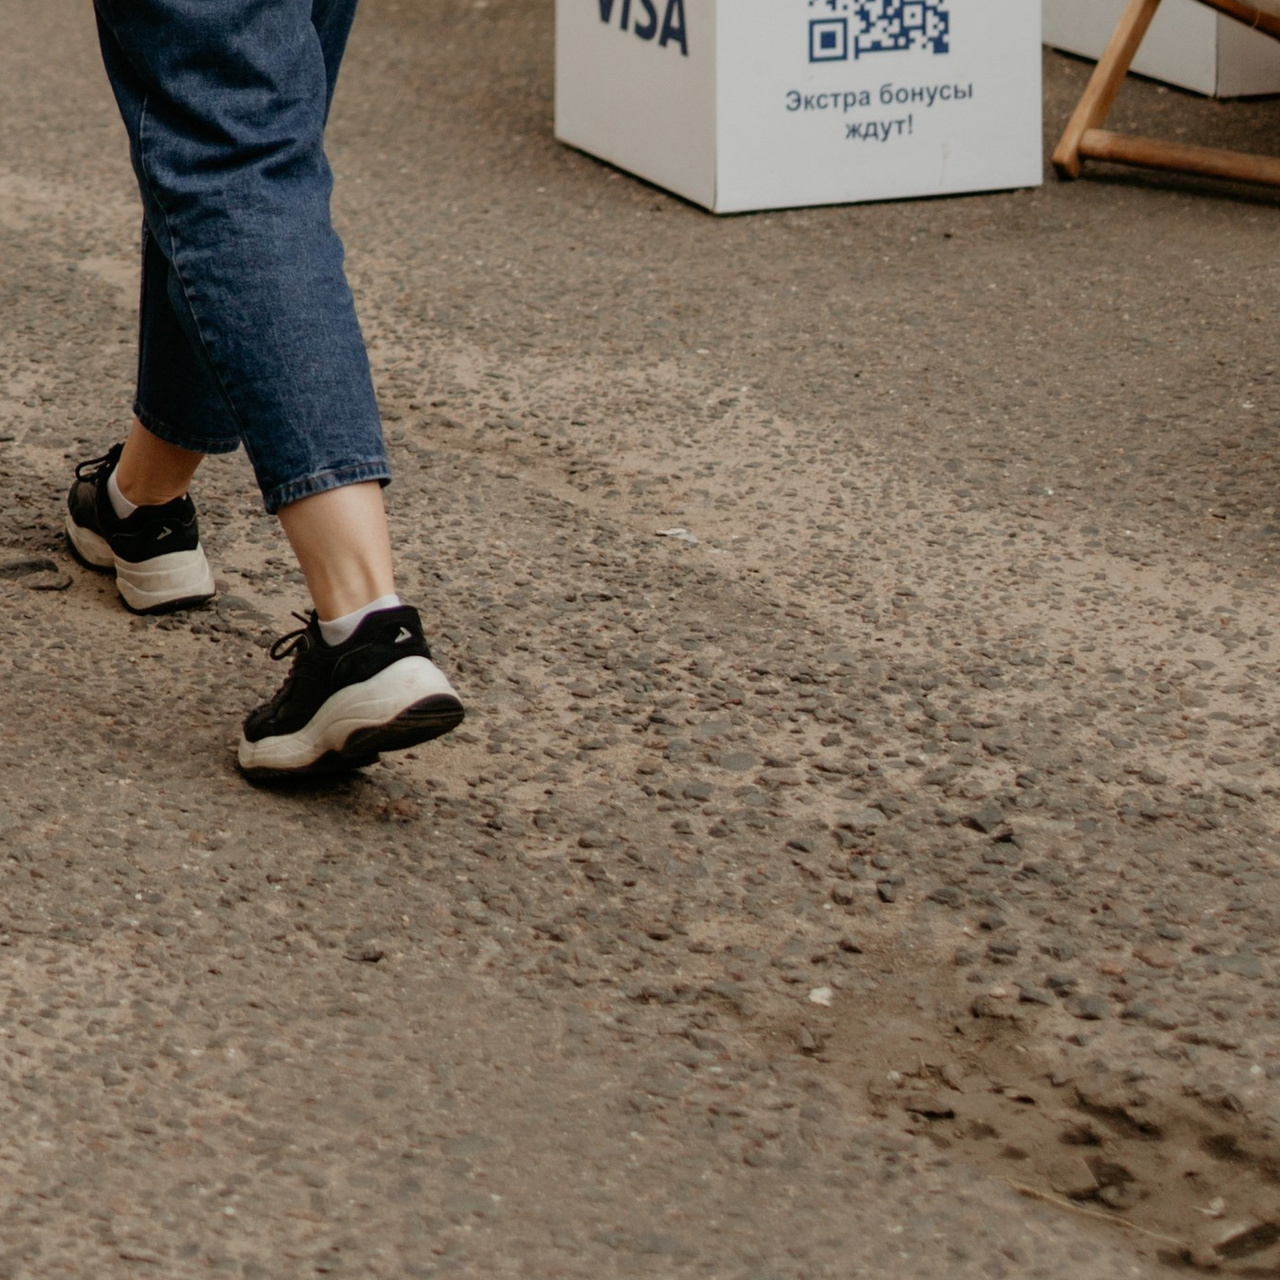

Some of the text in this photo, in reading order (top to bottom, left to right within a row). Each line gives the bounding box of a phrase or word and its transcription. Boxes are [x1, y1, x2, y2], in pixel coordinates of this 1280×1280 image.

[785, 82, 974, 113] Экстра бонусы
[845, 114, 914, 142] ждут!
